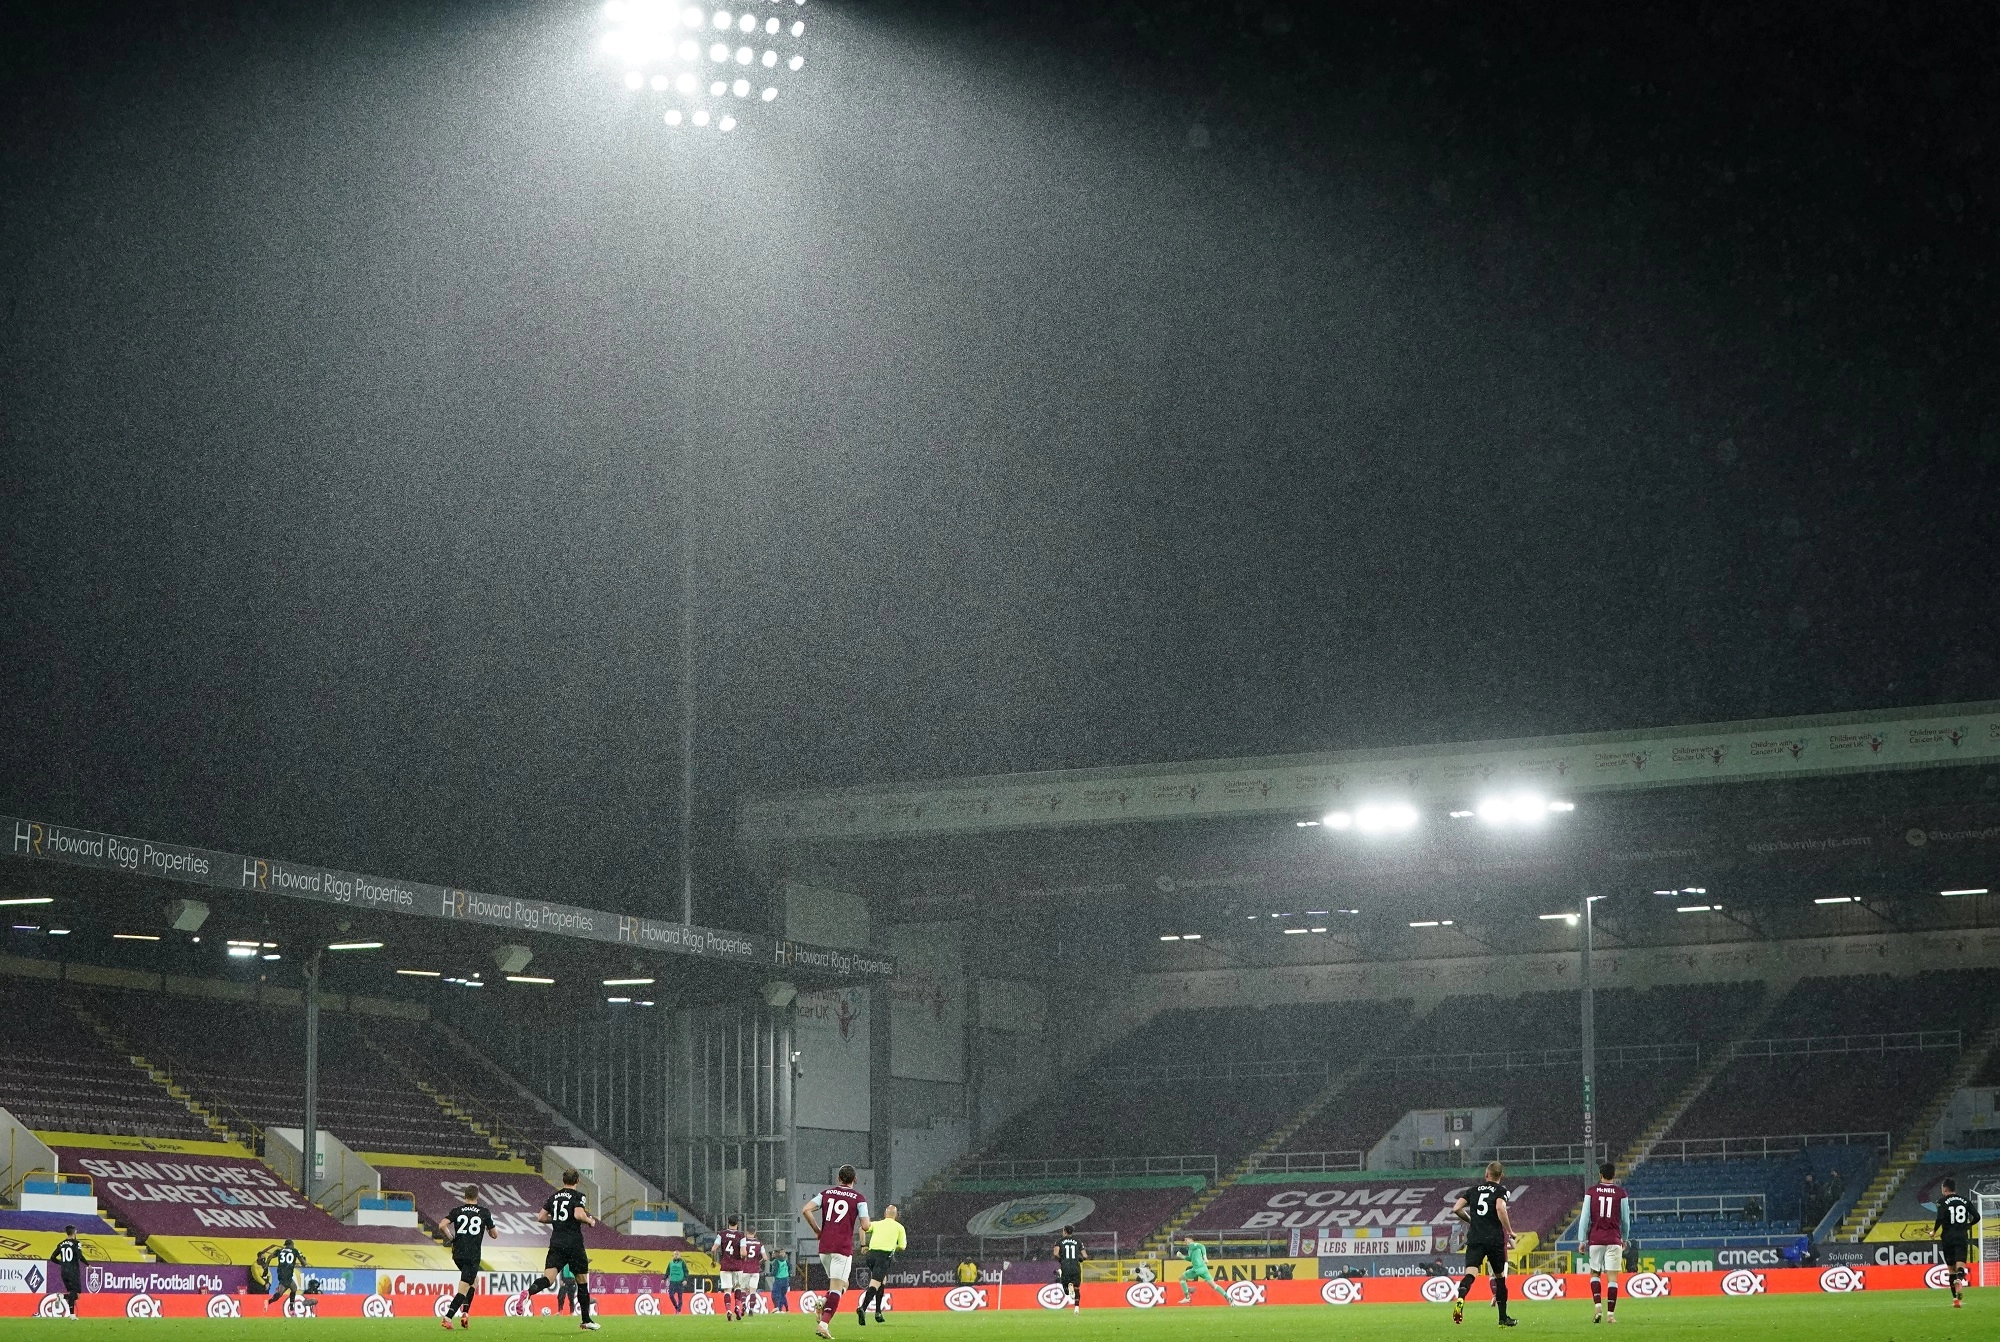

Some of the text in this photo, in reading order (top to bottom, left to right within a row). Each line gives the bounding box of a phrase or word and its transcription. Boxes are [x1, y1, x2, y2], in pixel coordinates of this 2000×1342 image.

[47, 829, 104, 857] Howard
[108, 838, 139, 869] Rigg
[143, 844, 209, 874] Properties
[272, 866, 320, 892] Howard
[324, 873, 351, 901] Rigg
[356, 878, 413, 906] Properties
[468, 895, 511, 919] Howard
[515, 902, 539, 928] Rigg
[542, 906, 593, 931] Properties
[641, 921, 680, 945] Howard
[682, 928, 704, 953] Rigg
[707, 933, 752, 955] Properties
[795, 945, 829, 967] Howard
[831, 951, 851, 974] Rigg
[1584, 1075, 1592, 1111] EXIT
[1454, 1118, 1464, 1130] B
[79, 1158, 278, 1187] SEAN DYCHE'S
[107, 1182, 306, 1210] CLARET & BLUE
[826, 1189, 858, 1200] RODRIGUEZ
[1266, 1187, 1436, 1208] COME
[1476, 1192, 1490, 1216] 5
[552, 1200, 570, 1221] 15
[825, 1198, 849, 1223] 19
[1598, 1196, 1613, 1218] 11
[1948, 1205, 1966, 1224] 18
[193, 1208, 276, 1229] ARMY
[457, 1214, 482, 1235] 28
[490, 1211, 553, 1236] SAF
[1240, 1207, 1472, 1229] BURNLE
[60, 1247, 73, 1262] 10
[724, 1240, 734, 1255] 4
[747, 1245, 756, 1258] 5
[1064, 1244, 1076, 1259] 11
[1323, 1239, 1426, 1254] LEGS HEARTS MINDS
[1717, 1248, 1779, 1265] cmecs
[1828, 1252, 1864, 1261] Solutions
[279, 1252, 294, 1264] 30
[104, 1272, 222, 1293] Burnley Football Club
[394, 1274, 454, 1295] Crown
[886, 1271, 920, 1286] urnley
